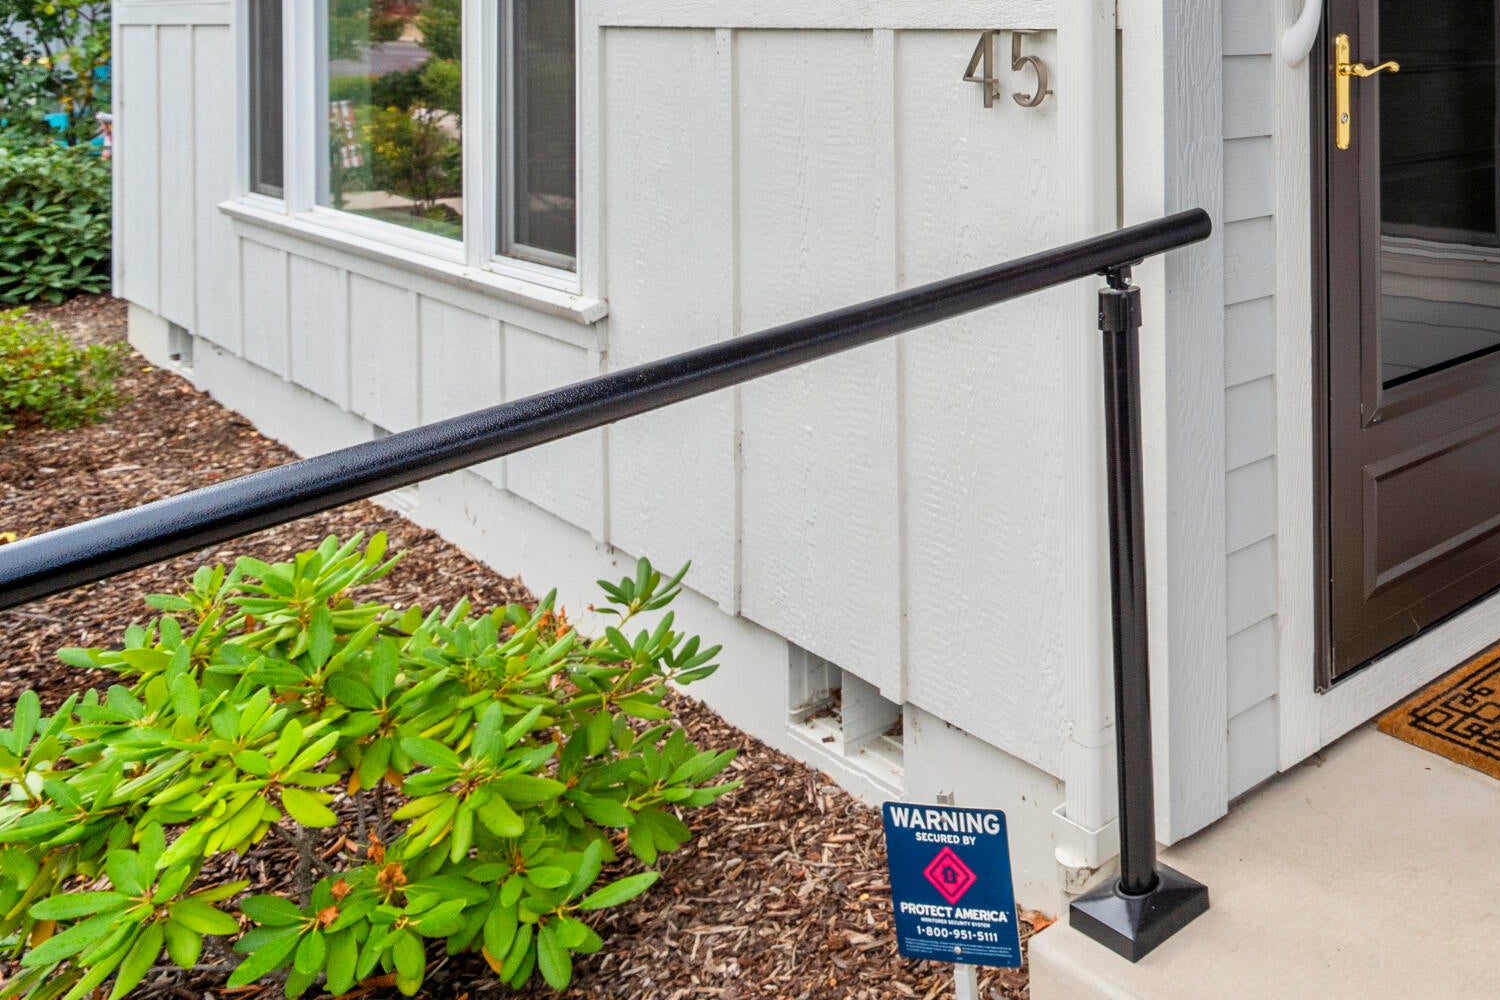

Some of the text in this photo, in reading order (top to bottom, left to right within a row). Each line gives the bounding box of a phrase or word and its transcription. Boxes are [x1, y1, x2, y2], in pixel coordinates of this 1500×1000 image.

[963, 30, 1053, 108] 45
[890, 806, 1000, 835] WARNING
[915, 832, 976, 845] SECURED BY
[900, 902, 952, 918] PROTECT
[916, 925, 998, 942] 1-800-951-5111
